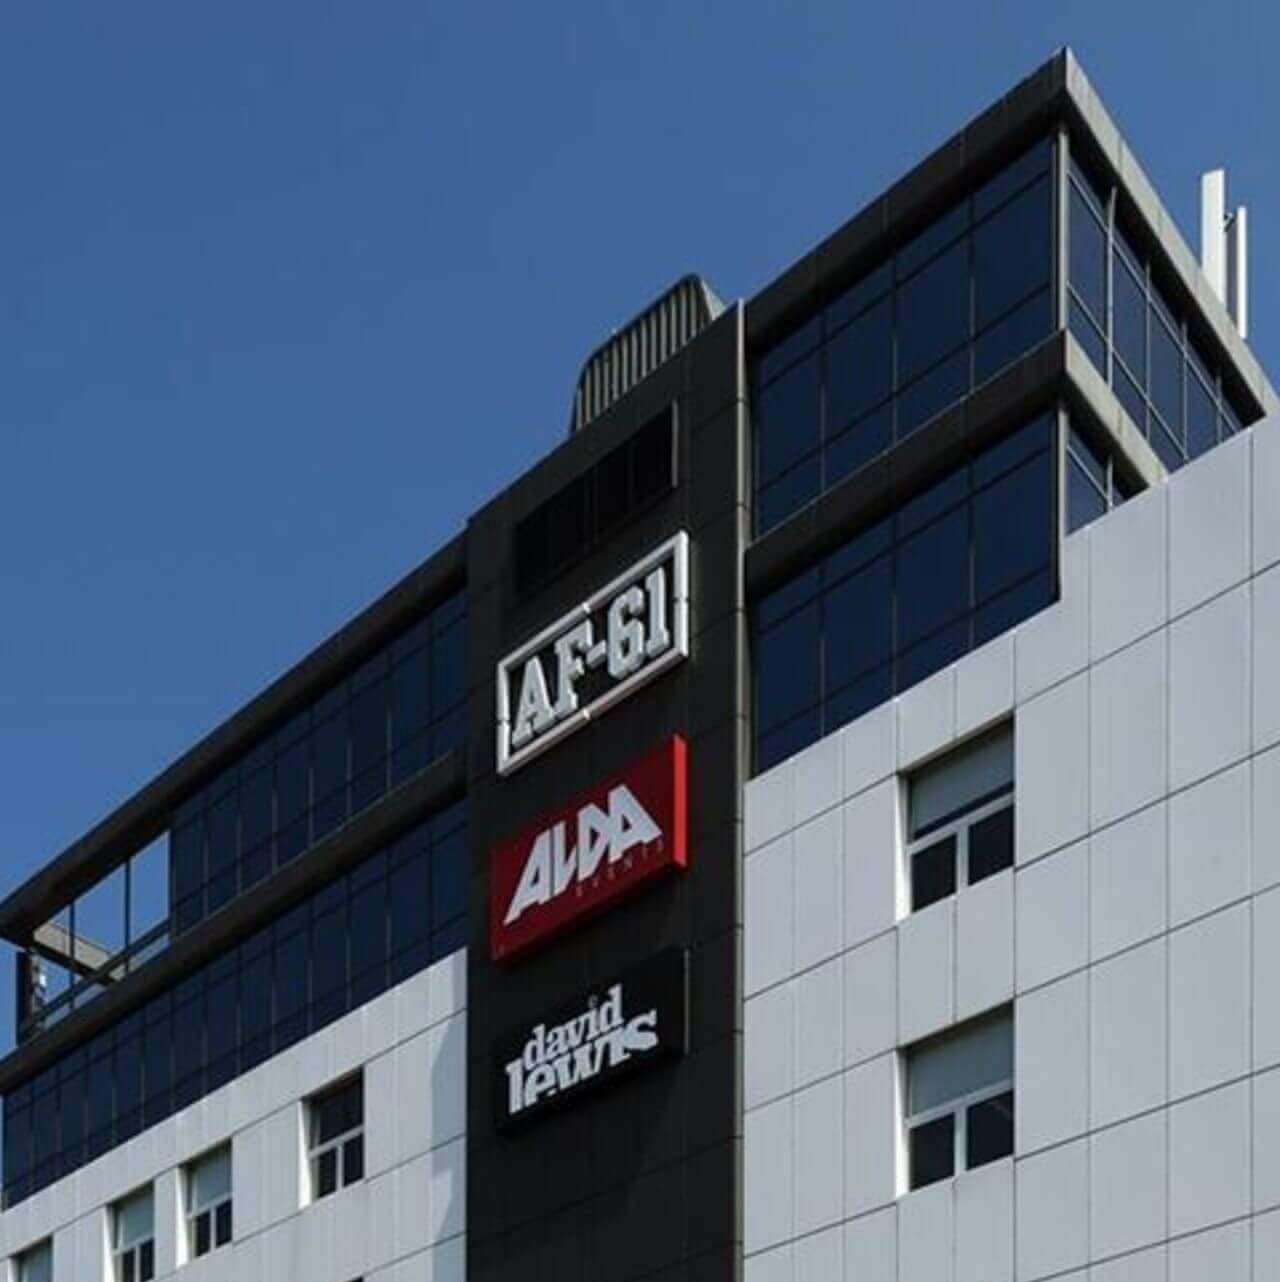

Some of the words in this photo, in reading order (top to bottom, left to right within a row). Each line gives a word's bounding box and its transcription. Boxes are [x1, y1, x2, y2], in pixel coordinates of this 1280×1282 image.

[511, 568, 670, 749] AF-61
[503, 784, 663, 927] ALDA
[505, 1007, 660, 1115] lewis
[522, 983, 625, 1071] david
